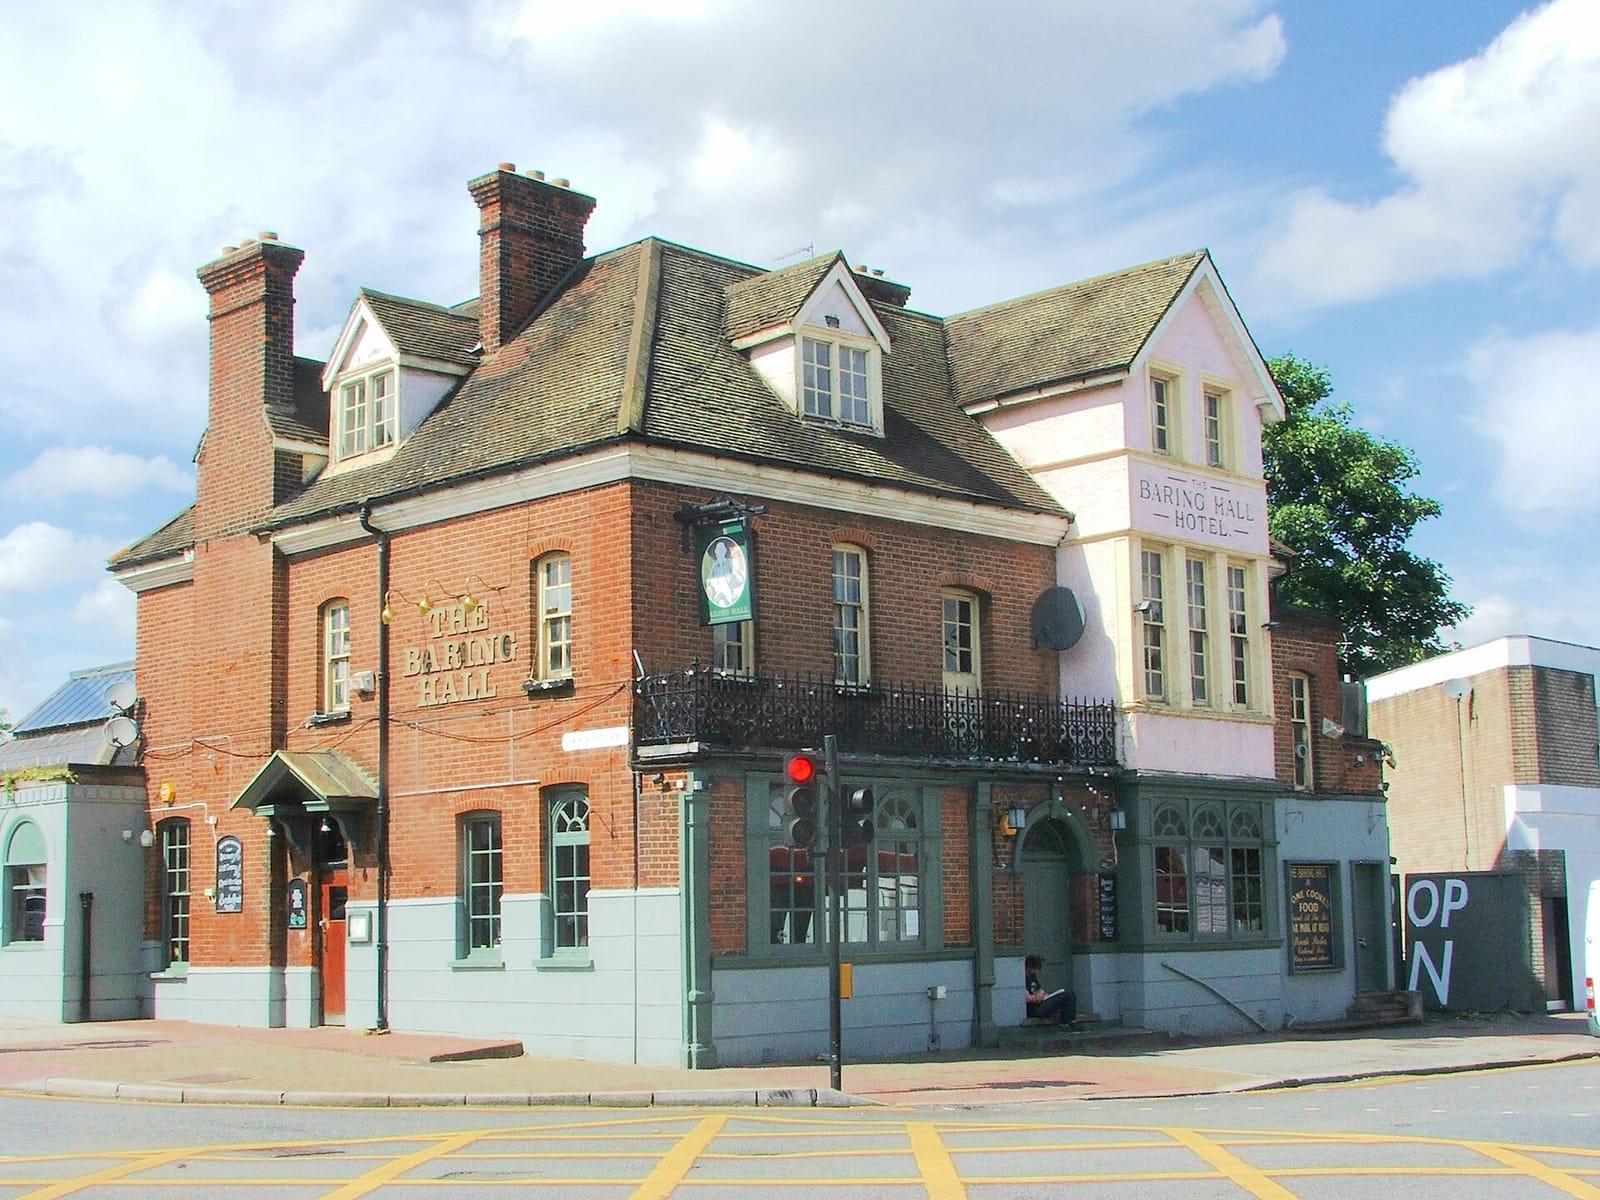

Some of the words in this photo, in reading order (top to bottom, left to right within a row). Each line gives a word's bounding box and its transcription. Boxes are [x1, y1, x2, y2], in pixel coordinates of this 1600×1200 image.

[1140, 479, 1206, 512] BARING
[1214, 495, 1255, 521] HALL
[429, 601, 490, 639] THE
[403, 632, 519, 678] BARING
[417, 669, 498, 708] HALL
[1299, 902, 1319, 913] FOOD
[1391, 879, 1469, 928] OP
